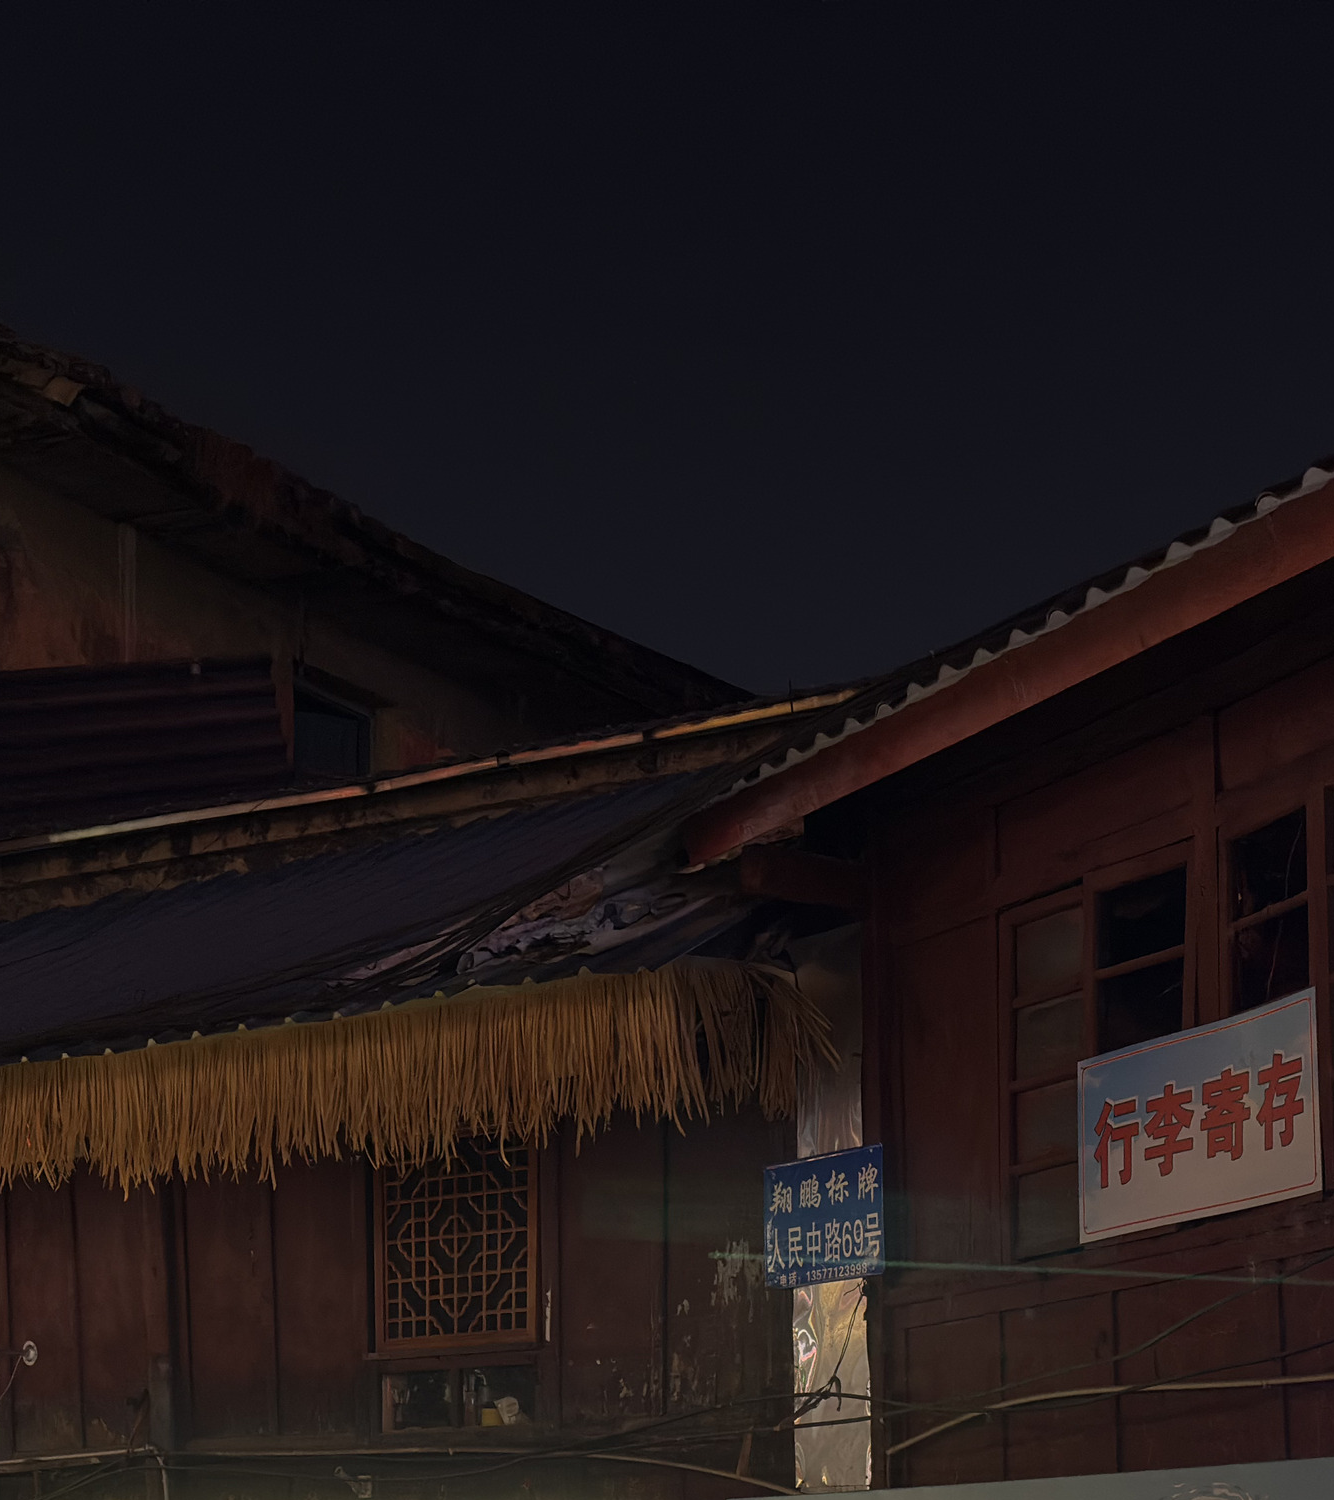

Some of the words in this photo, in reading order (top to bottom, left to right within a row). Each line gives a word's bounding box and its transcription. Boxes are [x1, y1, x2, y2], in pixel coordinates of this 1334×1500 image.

[1094, 1053, 1305, 1189] 行李寄存
[769, 1163, 879, 1216] 翔鹏标牌
[768, 1212, 882, 1273] 人民中路69号
